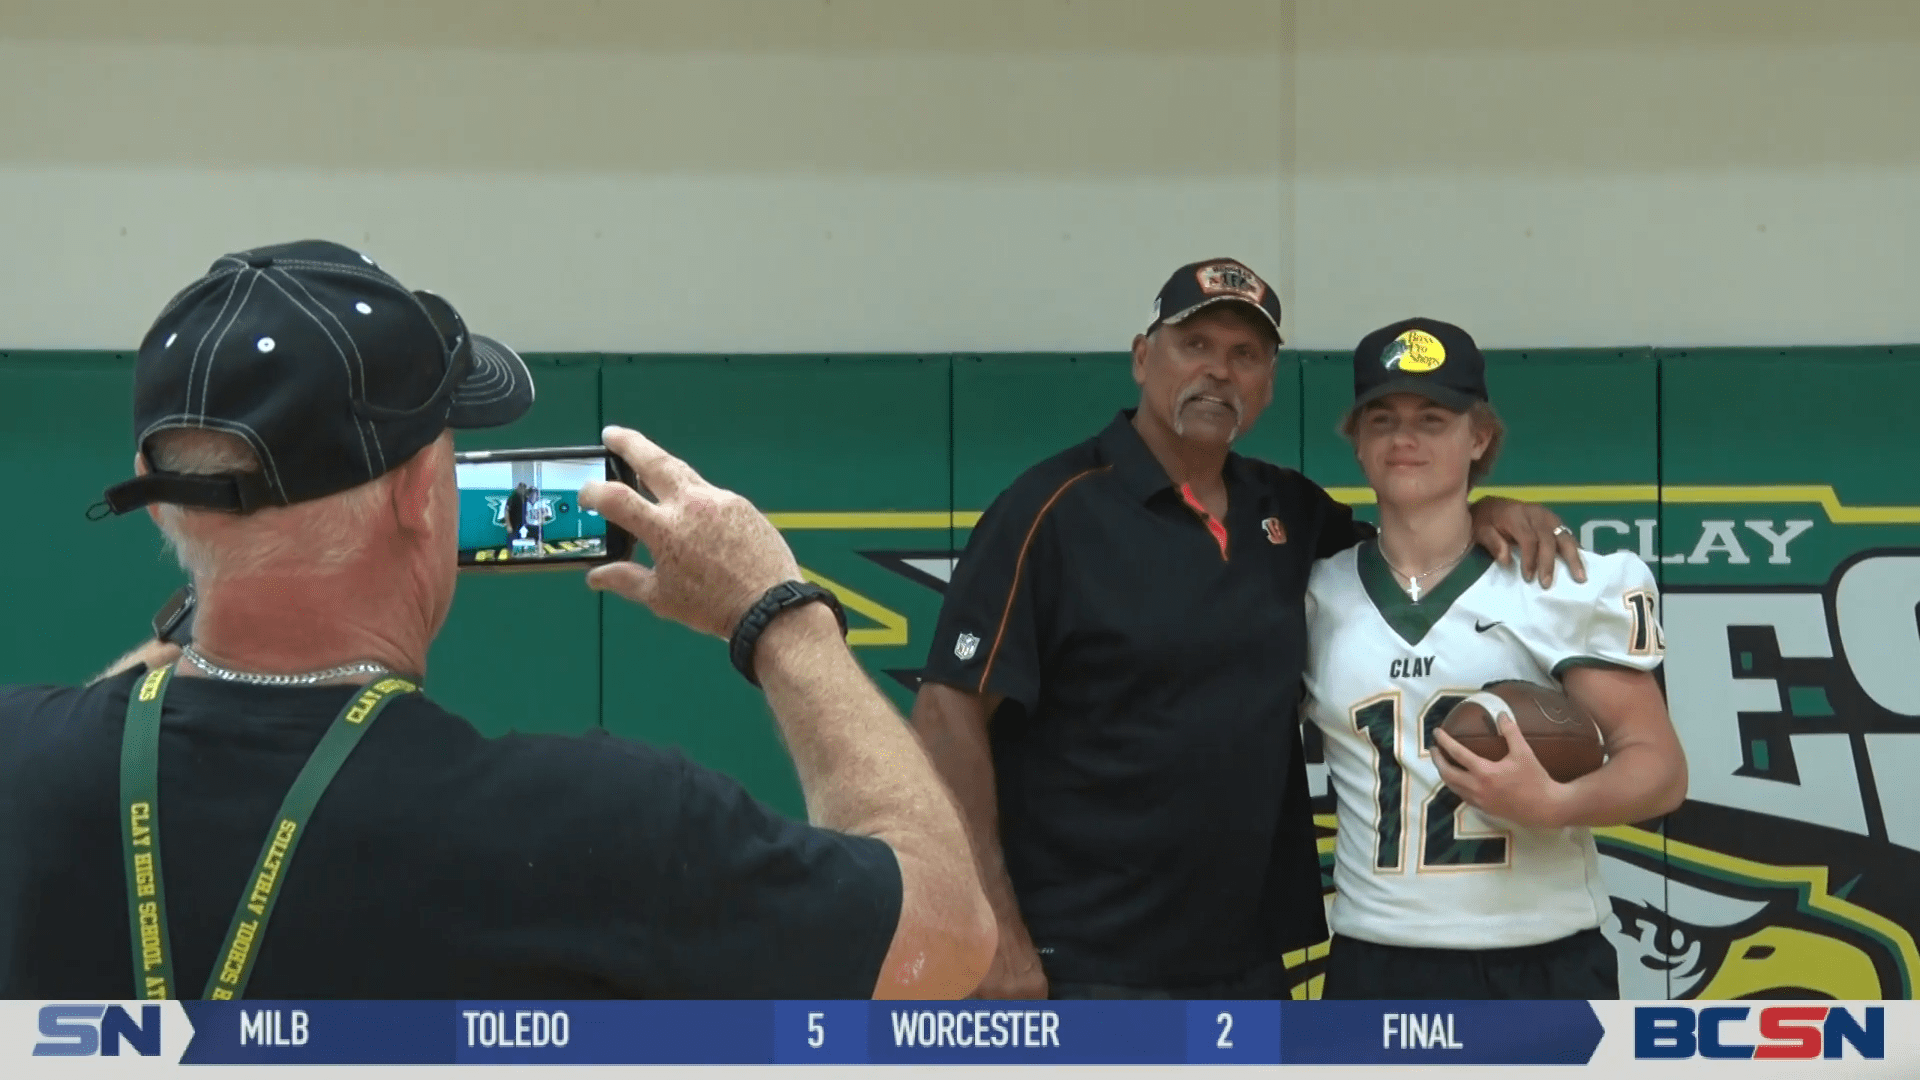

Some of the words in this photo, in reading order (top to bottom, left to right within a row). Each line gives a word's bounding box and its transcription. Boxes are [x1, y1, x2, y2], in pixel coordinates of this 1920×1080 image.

[1579, 519, 1814, 565] CLAY
[1390, 655, 1436, 679] CLAY
[346, 689, 382, 724] CLAY
[1350, 688, 1512, 875] 12
[131, 802, 151, 847] CLAY
[134, 852, 155, 897] HIGH
[220, 920, 260, 985] SCHOOL
[248, 819, 297, 916] ATHLETICS
[139, 901, 163, 971] SCHOOL
